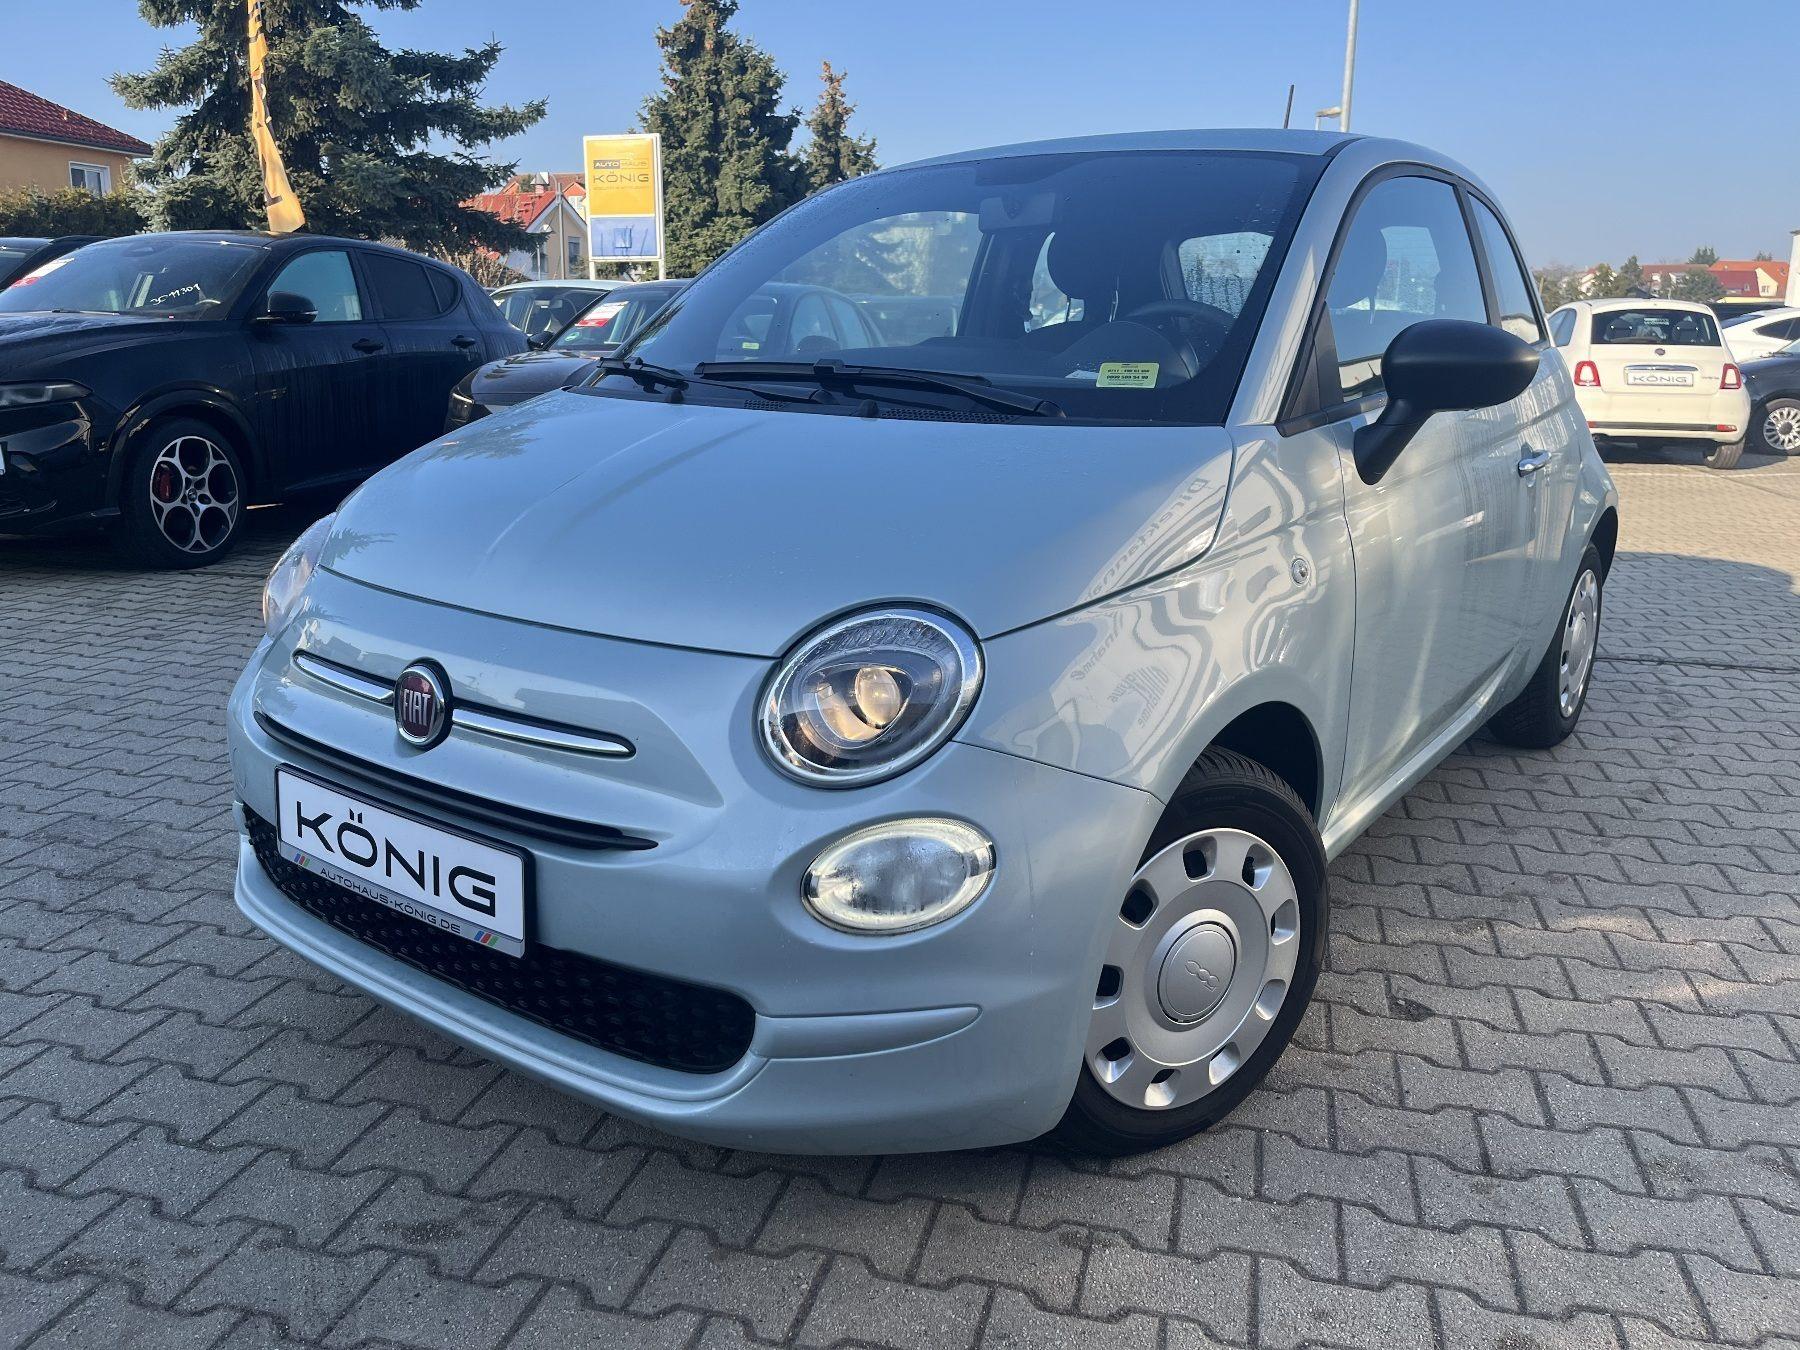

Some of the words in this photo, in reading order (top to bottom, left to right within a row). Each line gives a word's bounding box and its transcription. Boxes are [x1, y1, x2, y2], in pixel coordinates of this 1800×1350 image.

[593, 171, 649, 184] KÖNIG
[402, 688, 432, 727] FIAT
[296, 800, 496, 918] KÖNIG
[320, 867, 461, 934] AUTOHAUS-KÖNIG.DE
